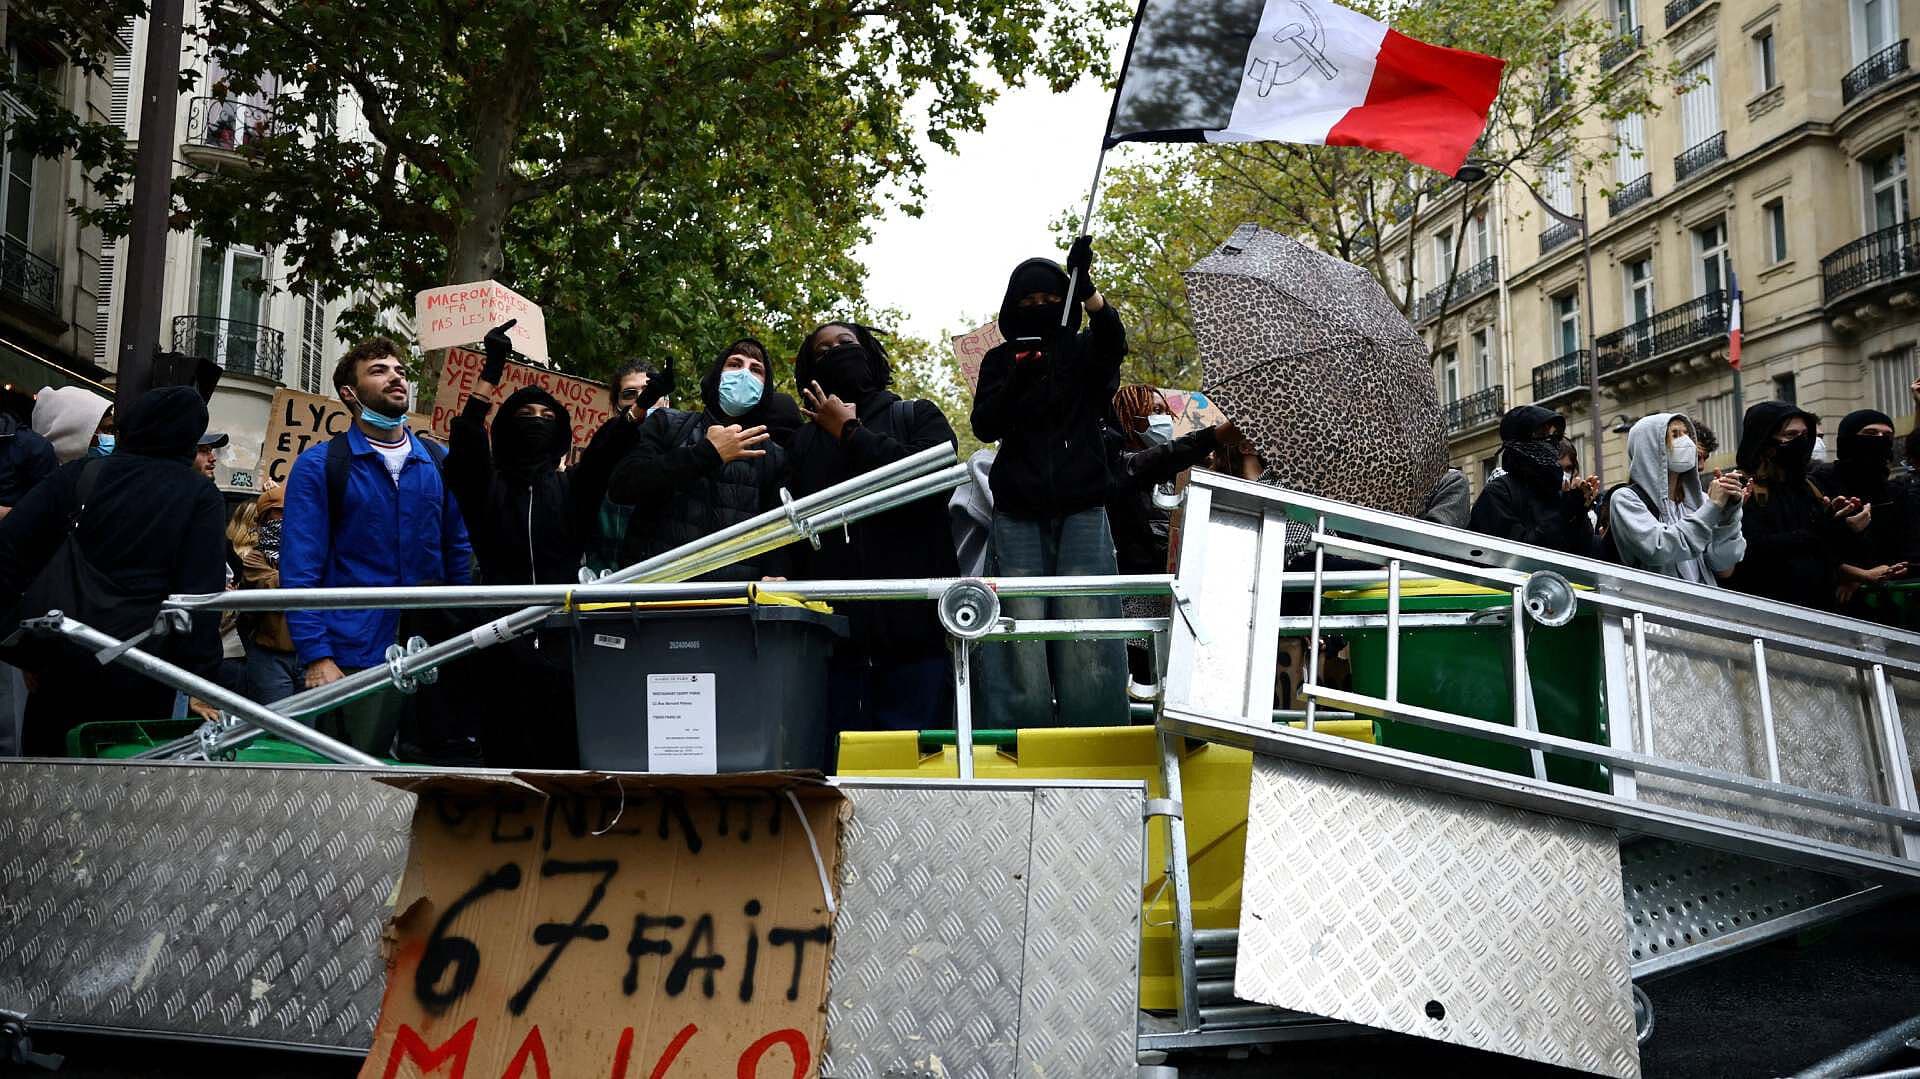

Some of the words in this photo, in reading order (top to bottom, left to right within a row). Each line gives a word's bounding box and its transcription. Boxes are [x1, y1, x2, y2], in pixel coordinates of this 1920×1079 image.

[427, 287, 491, 310] MACRON
[445, 303, 467, 313] TA
[432, 317, 453, 333] PAS
[462, 313, 484, 327] LES
[555, 378, 597, 405] NOS
[414, 861, 619, 1017] 67
